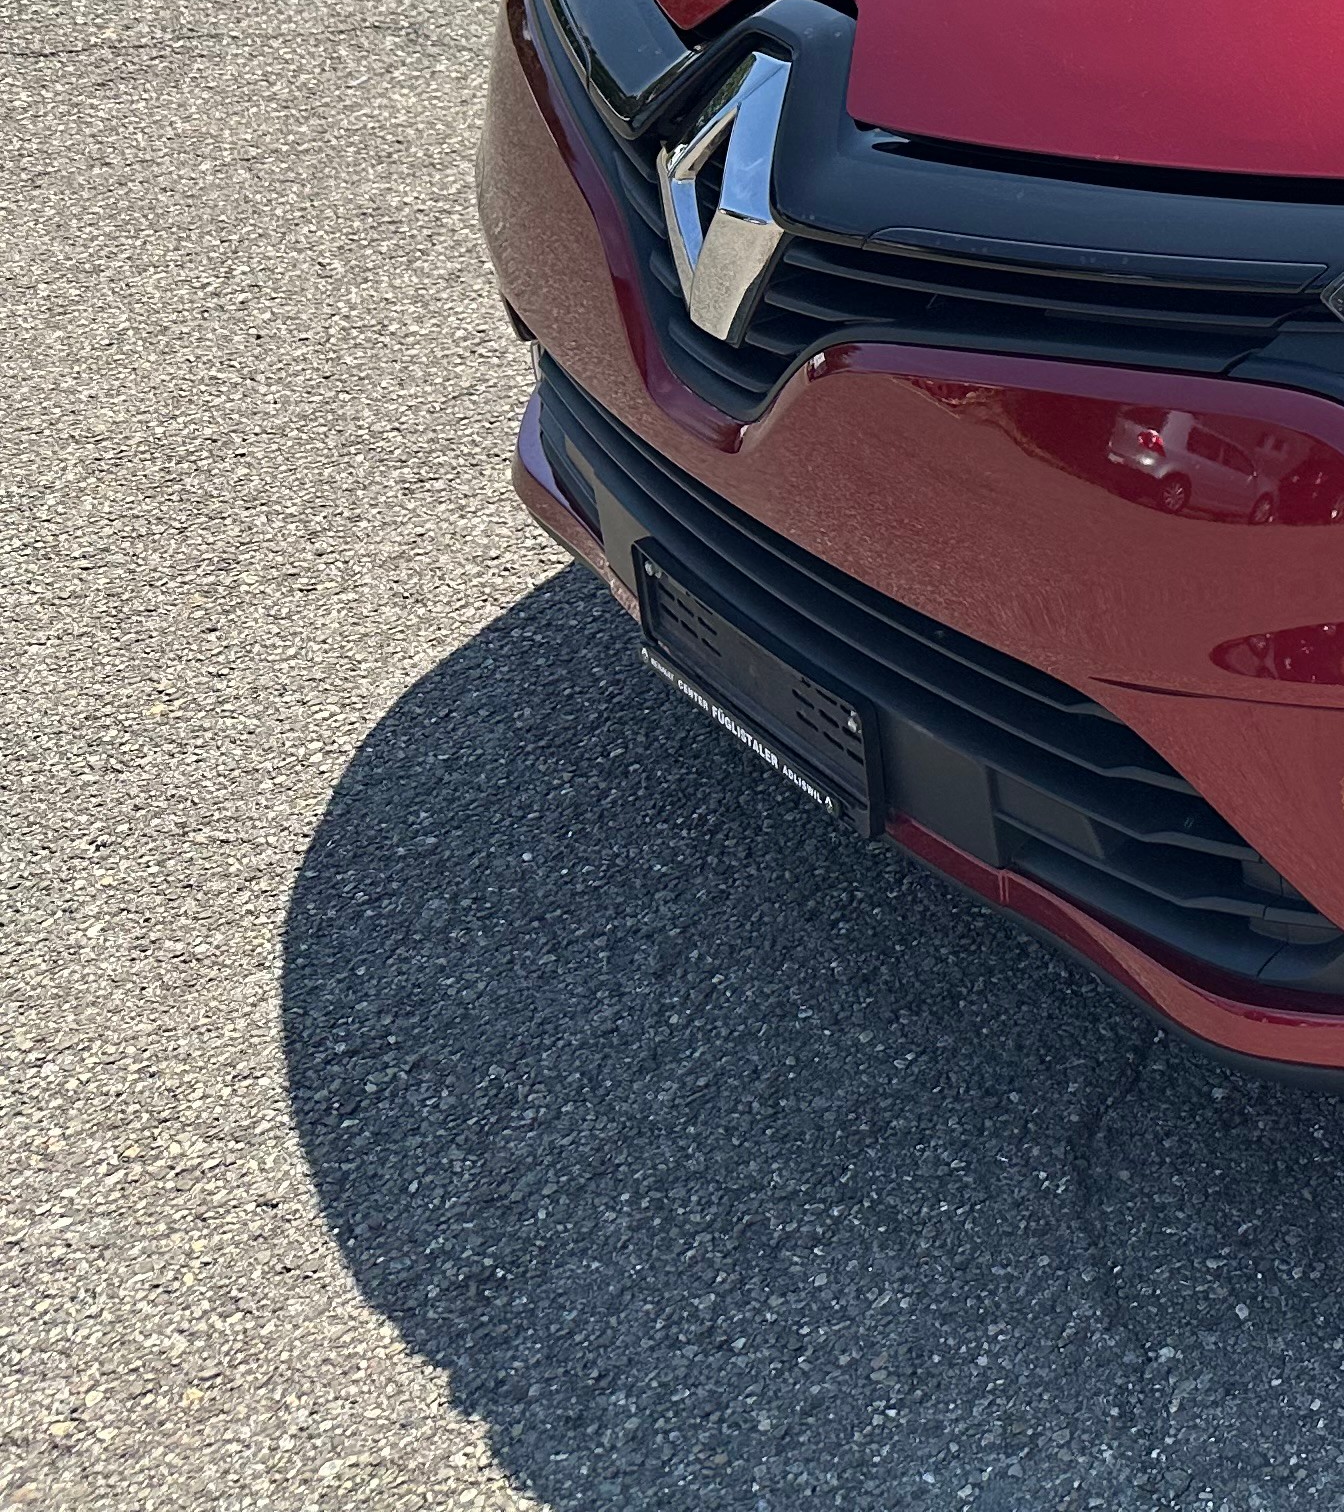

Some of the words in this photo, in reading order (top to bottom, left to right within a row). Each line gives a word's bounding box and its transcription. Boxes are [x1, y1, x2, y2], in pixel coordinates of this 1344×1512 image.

[677, 679, 709, 712] CENTER
[711, 704, 779, 770] FÜGLISTALER
[782, 764, 823, 804] ADLISWIL
